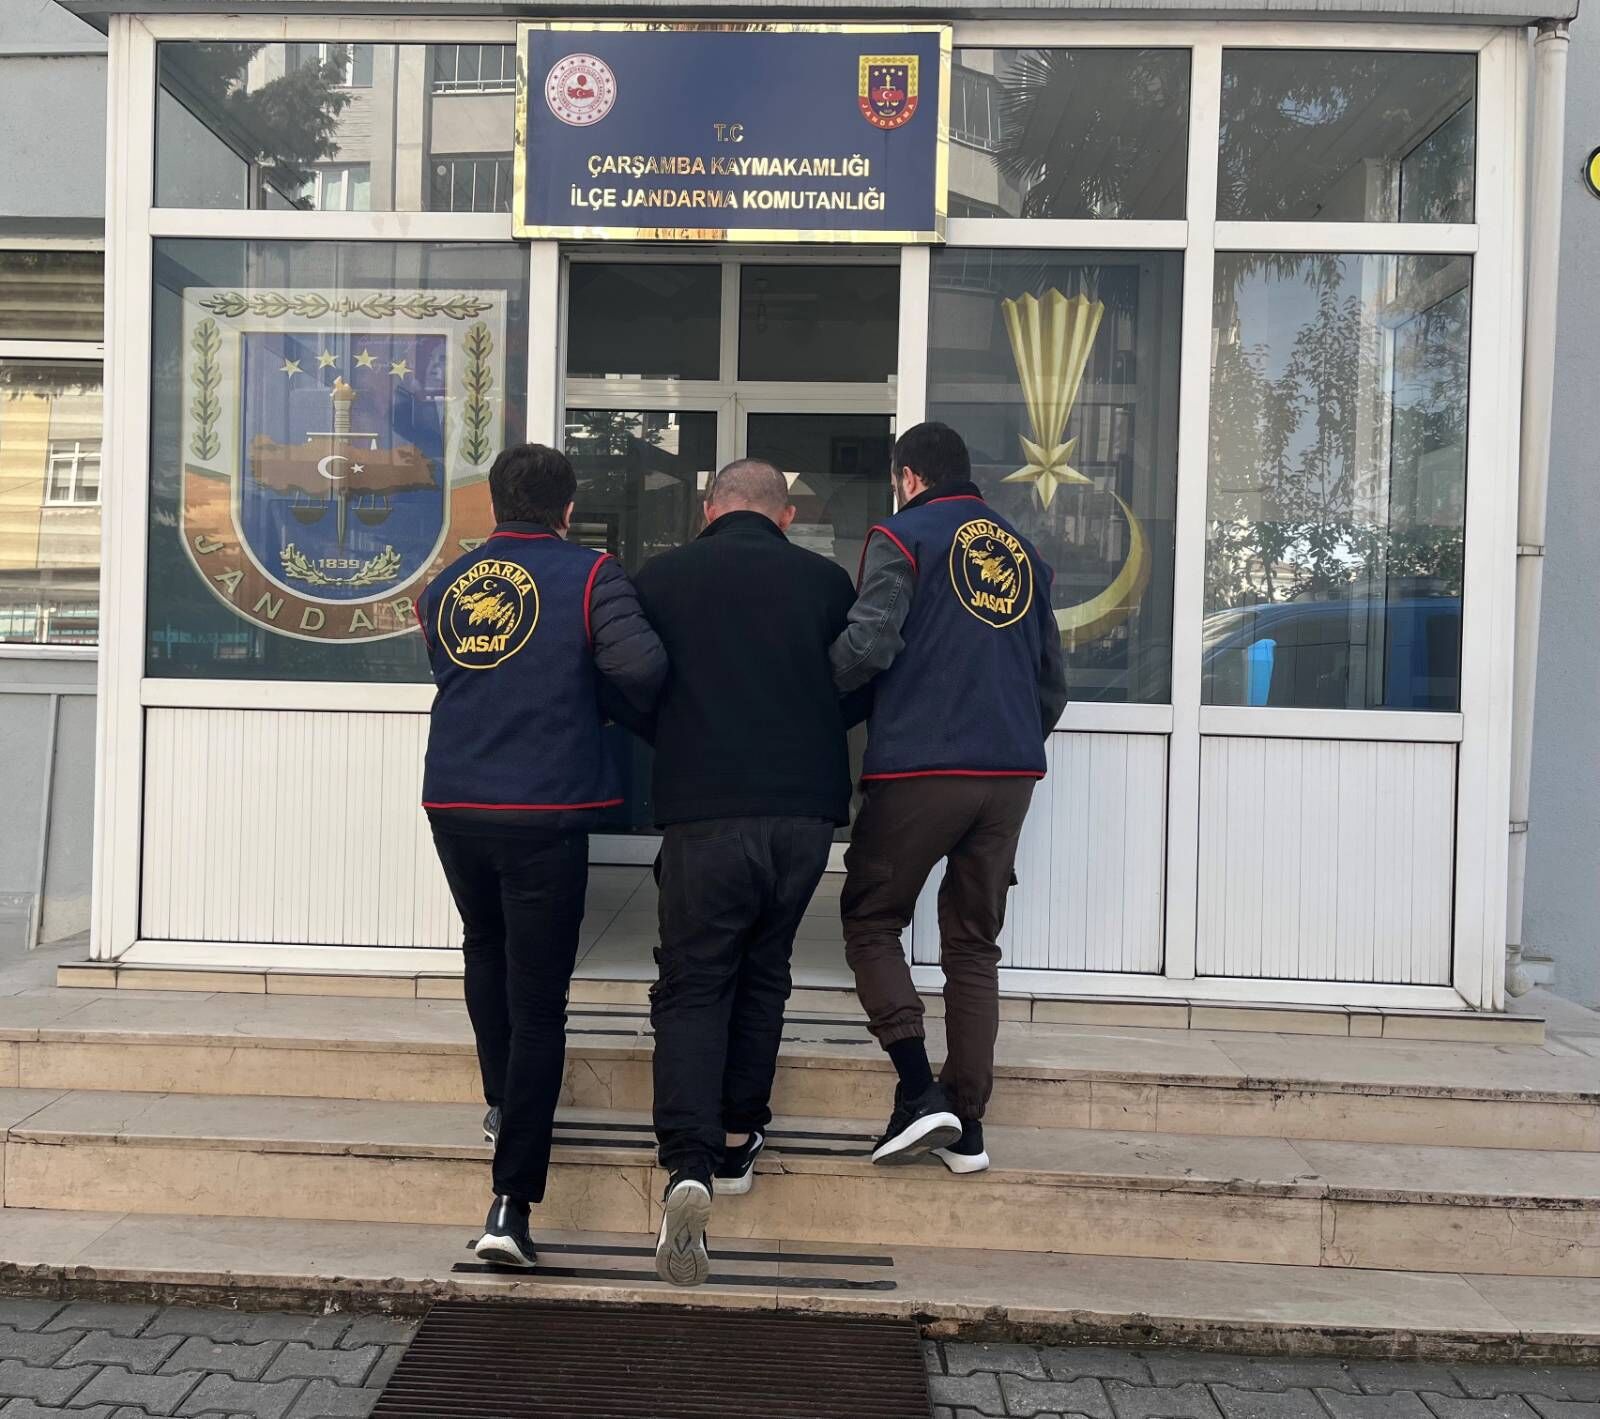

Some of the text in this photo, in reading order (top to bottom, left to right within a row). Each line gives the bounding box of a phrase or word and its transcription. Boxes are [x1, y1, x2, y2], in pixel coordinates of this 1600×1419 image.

[861, 104, 914, 126] JANDARMA
[714, 123, 744, 142] T.C
[588, 154, 870, 178] ÇARŞAMBA KAYMAKAMLIĞI
[571, 184, 886, 211] İLÇE JANDARMA KOMUTANLIĞI
[958, 523, 1025, 564] JANDARMA
[318, 558, 360, 569] 1839
[194, 535, 488, 633] JANDARA
[451, 562, 532, 599] JANDARMA
[970, 590, 1015, 614] JASAT
[456, 633, 510, 654] JASAT
